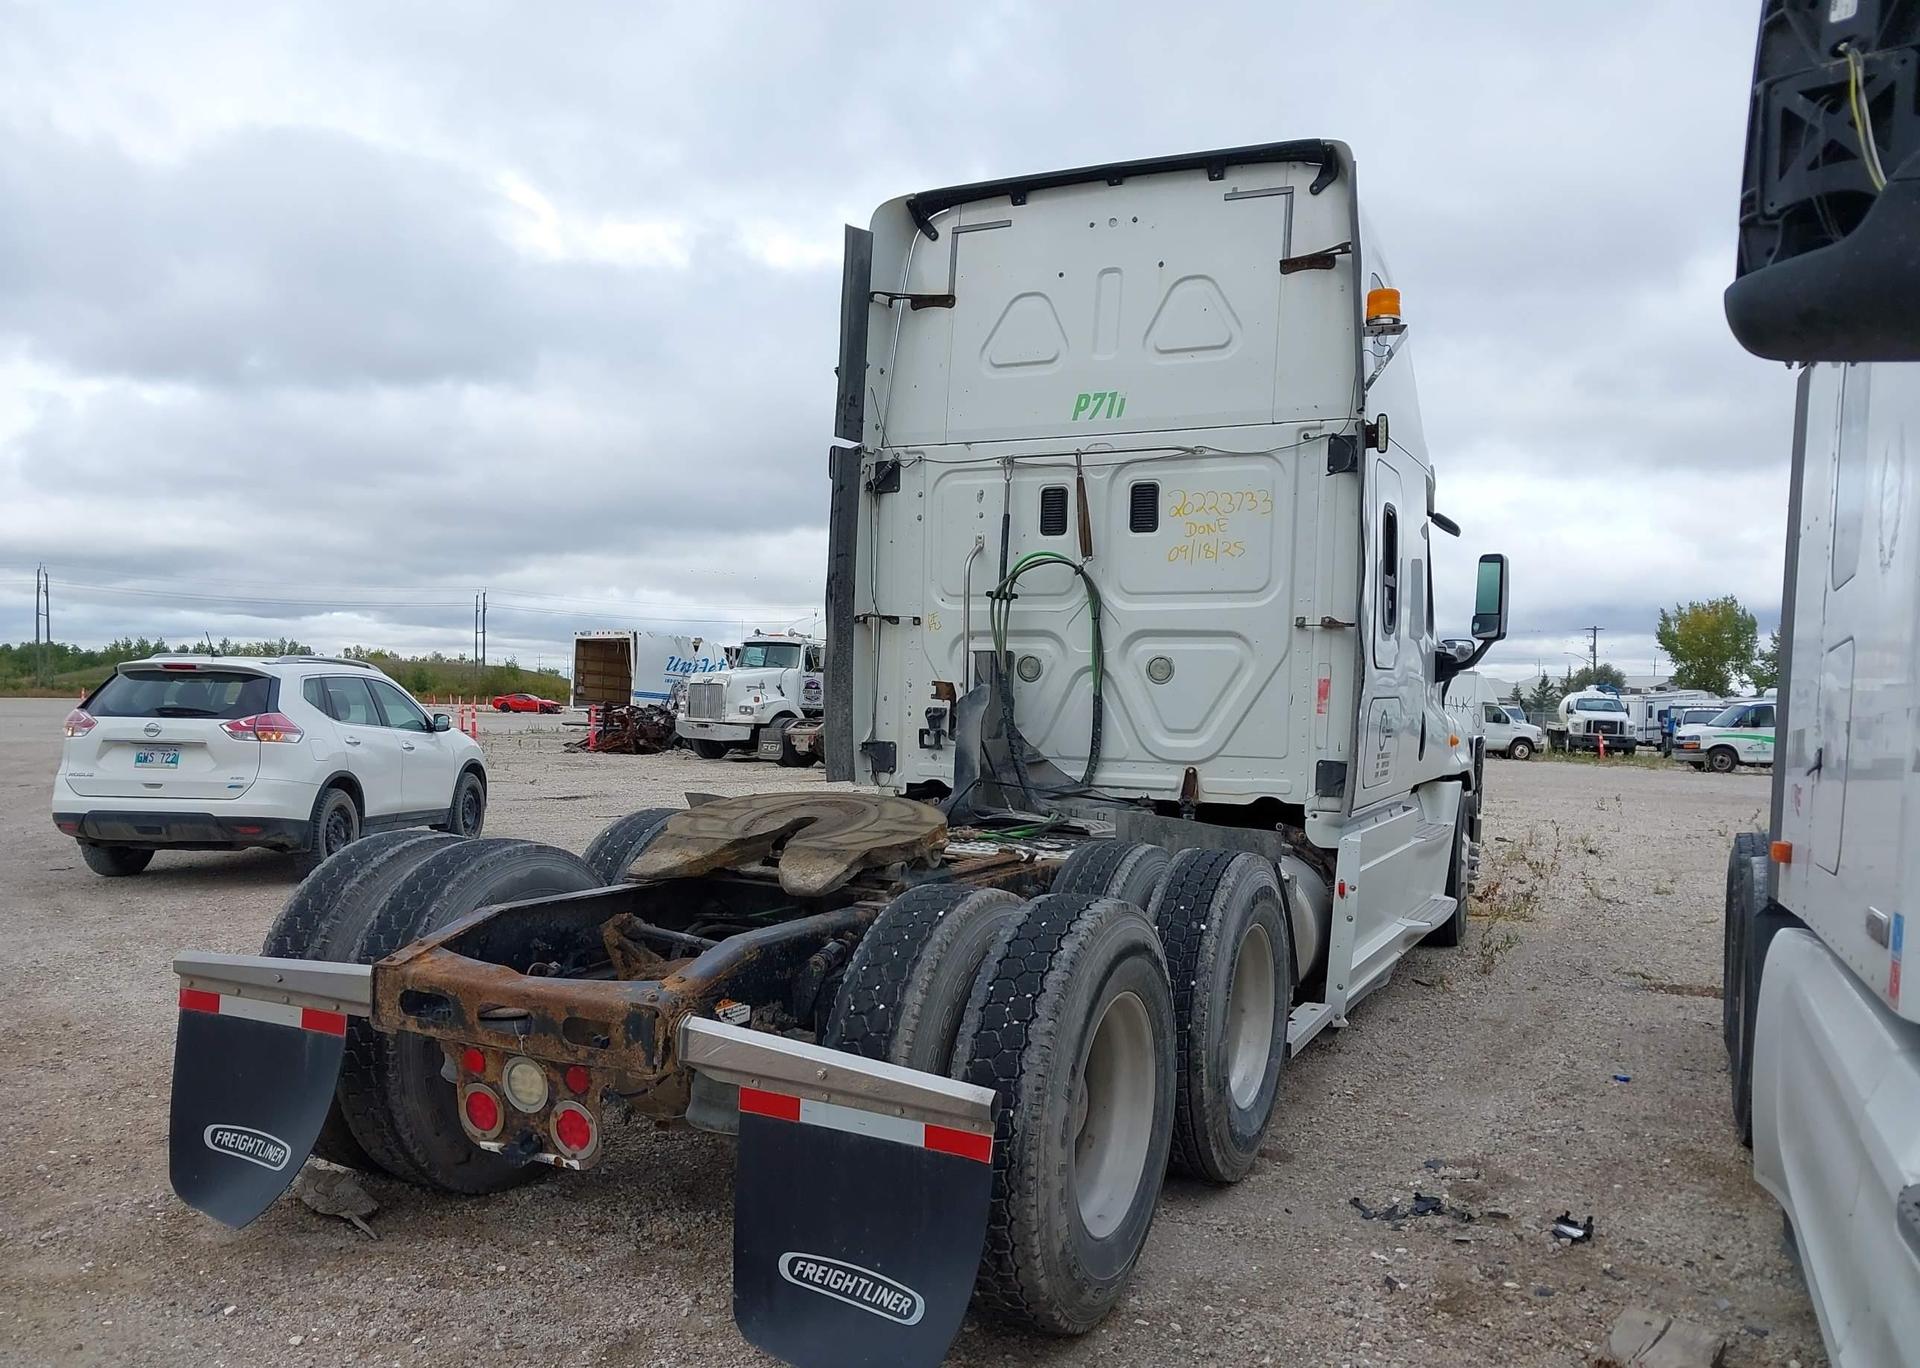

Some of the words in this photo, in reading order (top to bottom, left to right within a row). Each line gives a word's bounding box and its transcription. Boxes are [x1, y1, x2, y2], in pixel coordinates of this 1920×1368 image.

[1167, 489, 1273, 517] 20223733
[1184, 518, 1229, 537] DONE
[1167, 538, 1246, 565] 09/18/25
[137, 751, 155, 763] GWS
[160, 752, 177, 764] 722
[214, 1130, 285, 1164] FREIGHTLINER
[793, 1260, 912, 1316] FREIGHTLINER
